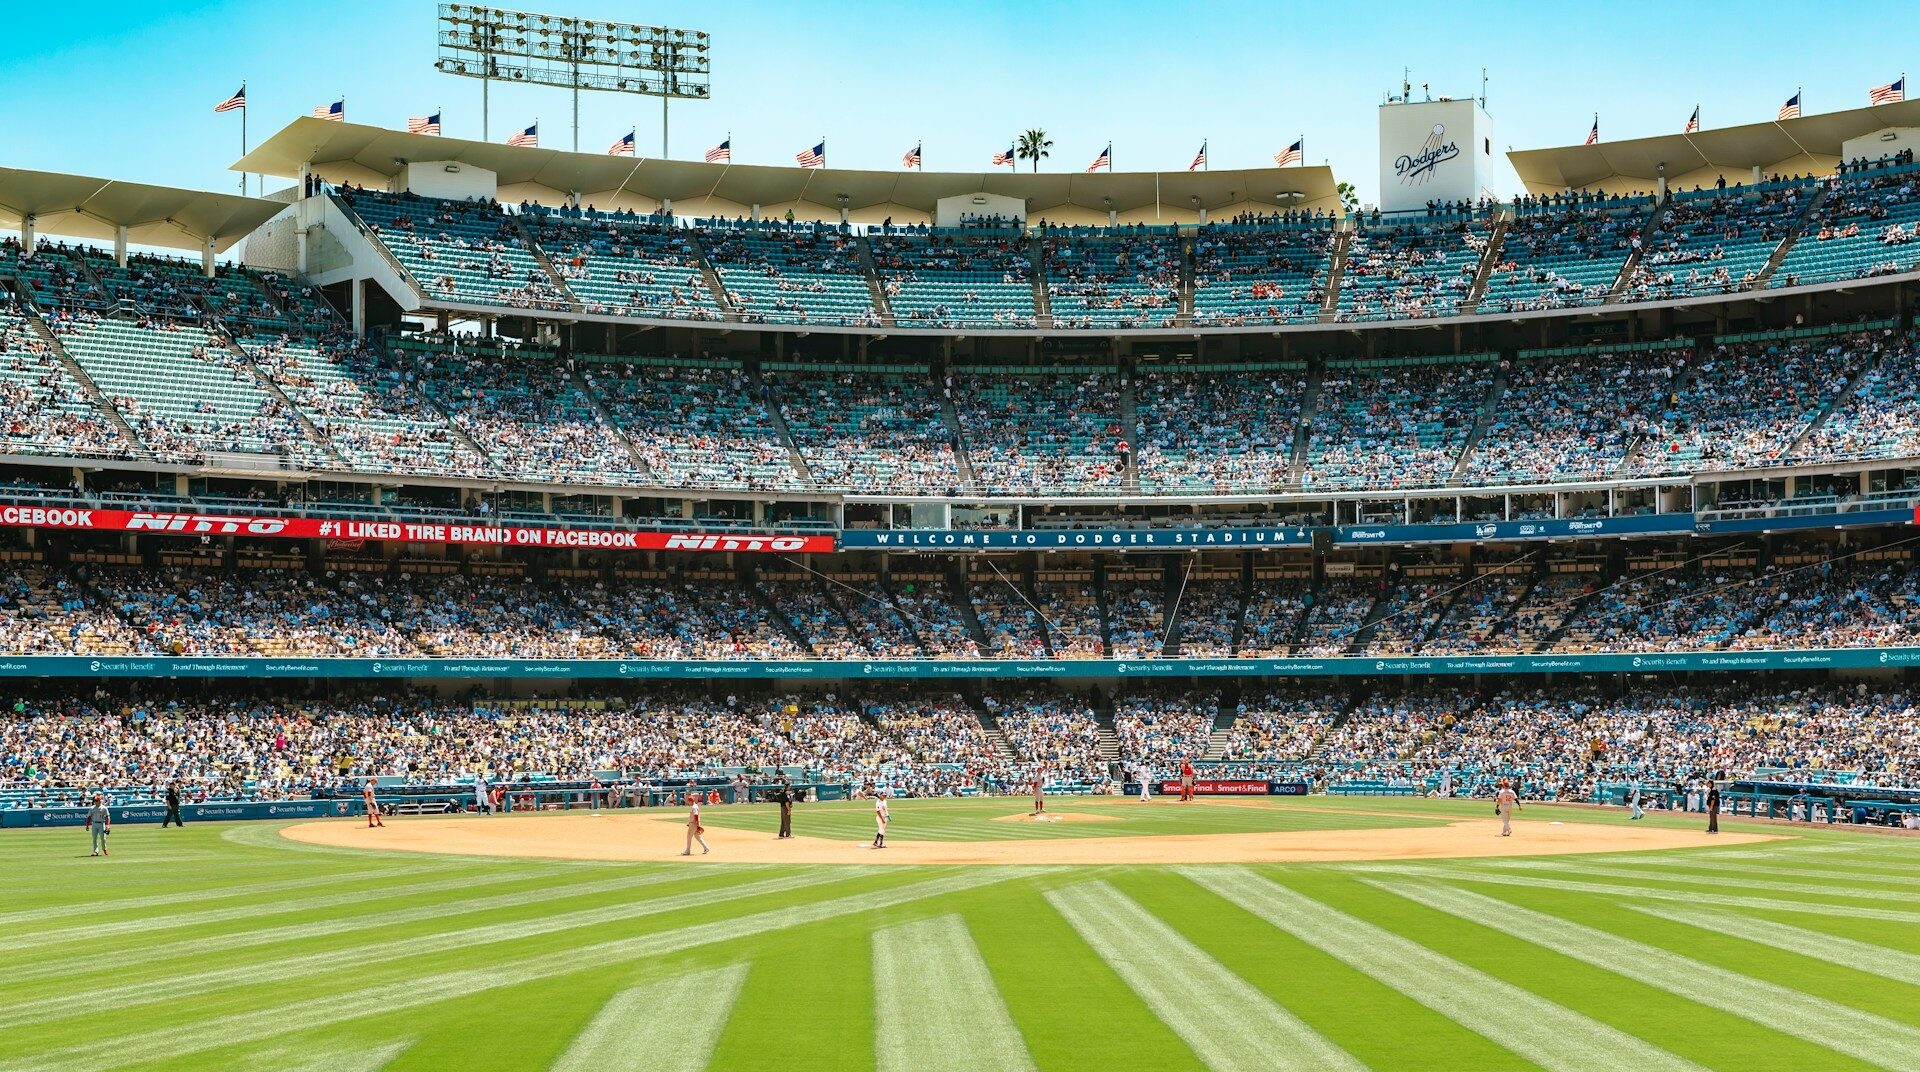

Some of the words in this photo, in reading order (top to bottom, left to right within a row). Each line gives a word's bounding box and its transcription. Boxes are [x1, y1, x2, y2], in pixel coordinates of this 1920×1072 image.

[1395, 141, 1460, 177] Dodgers
[0, 507, 93, 526] CEBOOK
[126, 513, 288, 534] NITTO
[319, 521, 341, 537] #1
[348, 522, 401, 539] LIKED
[405, 524, 446, 541] TIRE
[450, 526, 512, 543] BRAND
[516, 529, 541, 544] ON
[546, 530, 638, 548] FACEBOOK
[876, 534, 990, 544] WELCOME
[1010, 534, 1037, 544] TO
[1057, 533, 1154, 544] DODGER
[1175, 532, 1285, 543] STADIUM
[664, 535, 807, 550] NITTO
[1642, 656, 1665, 666] Security
[1888, 653, 1910, 661] Security
[101, 662, 128, 671] Security
[382, 664, 405, 672] Security
[628, 665, 650, 673] Security
[873, 665, 896, 673] Security
[1127, 664, 1151, 672] Security
[1385, 660, 1409, 670] Security
[1274, 785, 1297, 794] ARCO
